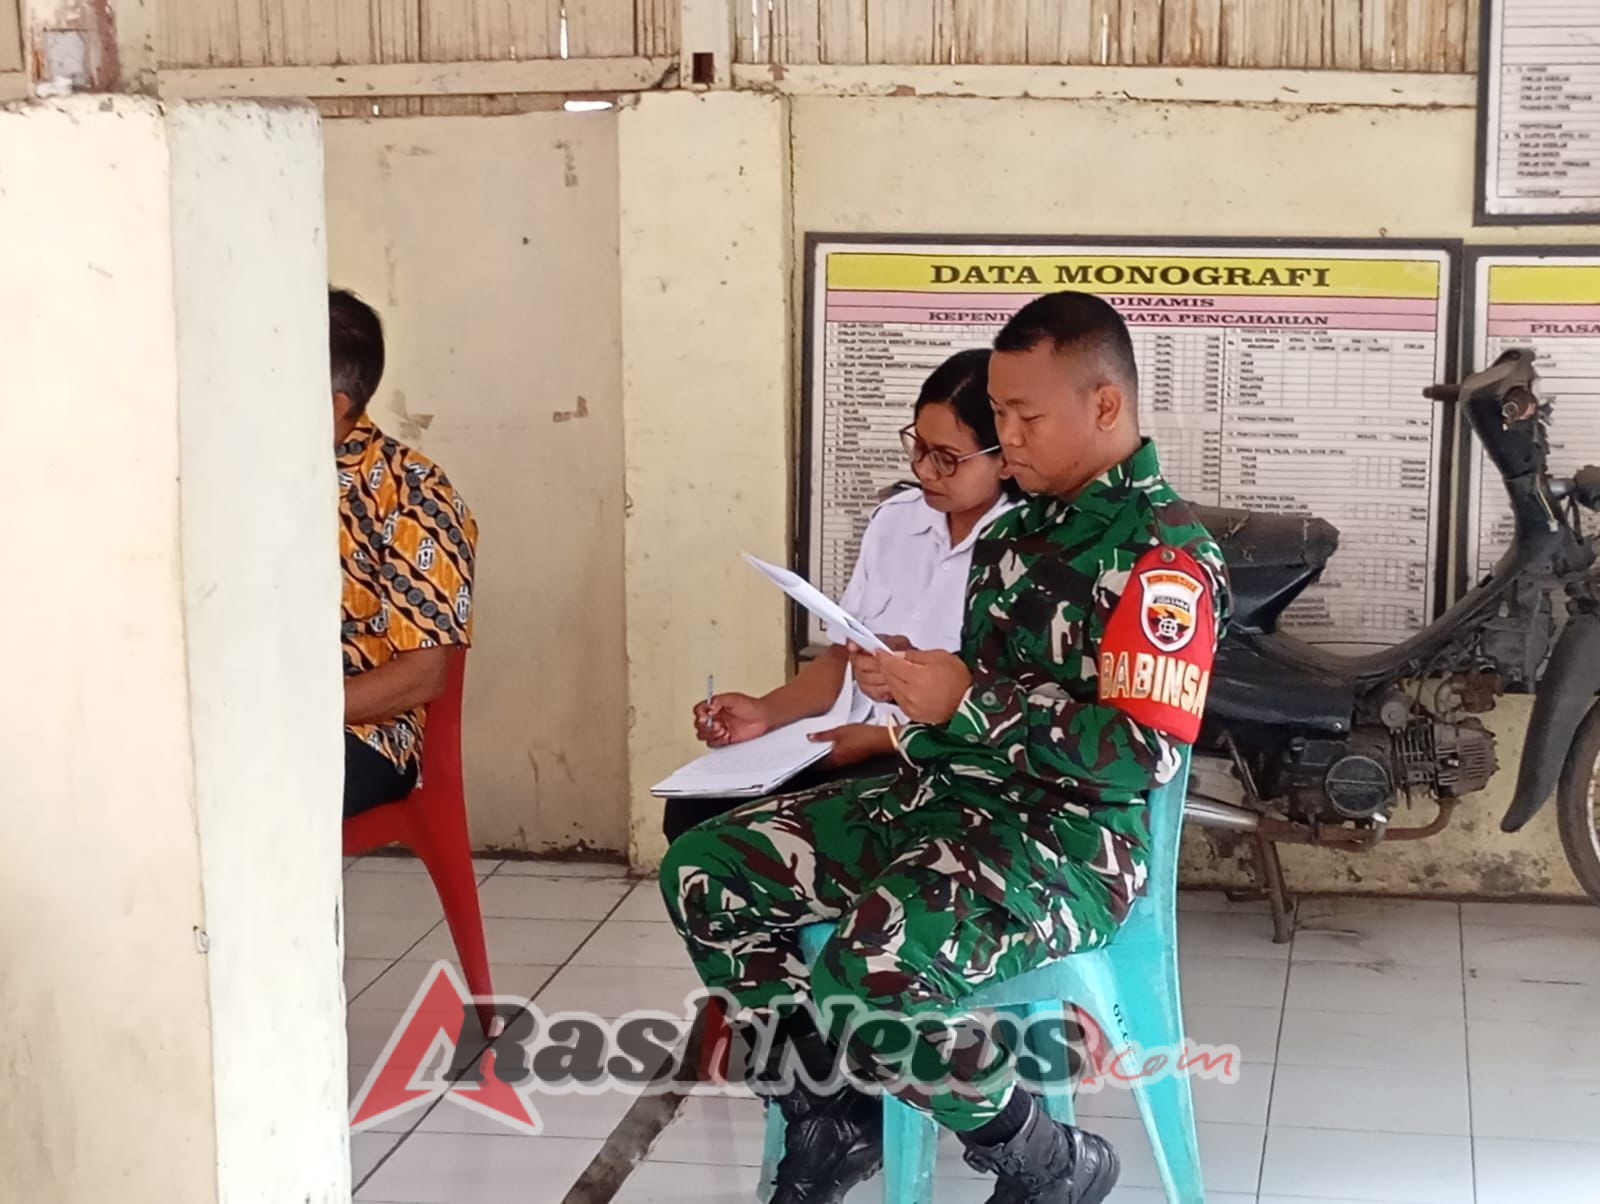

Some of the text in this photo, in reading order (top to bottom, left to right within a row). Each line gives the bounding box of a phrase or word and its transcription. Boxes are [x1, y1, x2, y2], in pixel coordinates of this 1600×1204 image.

[930, 265, 1331, 287] DATA MONOGRAFI
[1110, 297, 1215, 307] DINAMIS
[928, 311, 1012, 322] KEPEND
[1178, 314, 1329, 325] PENCAHARIAN
[1100, 651, 1210, 721] BABINSA
